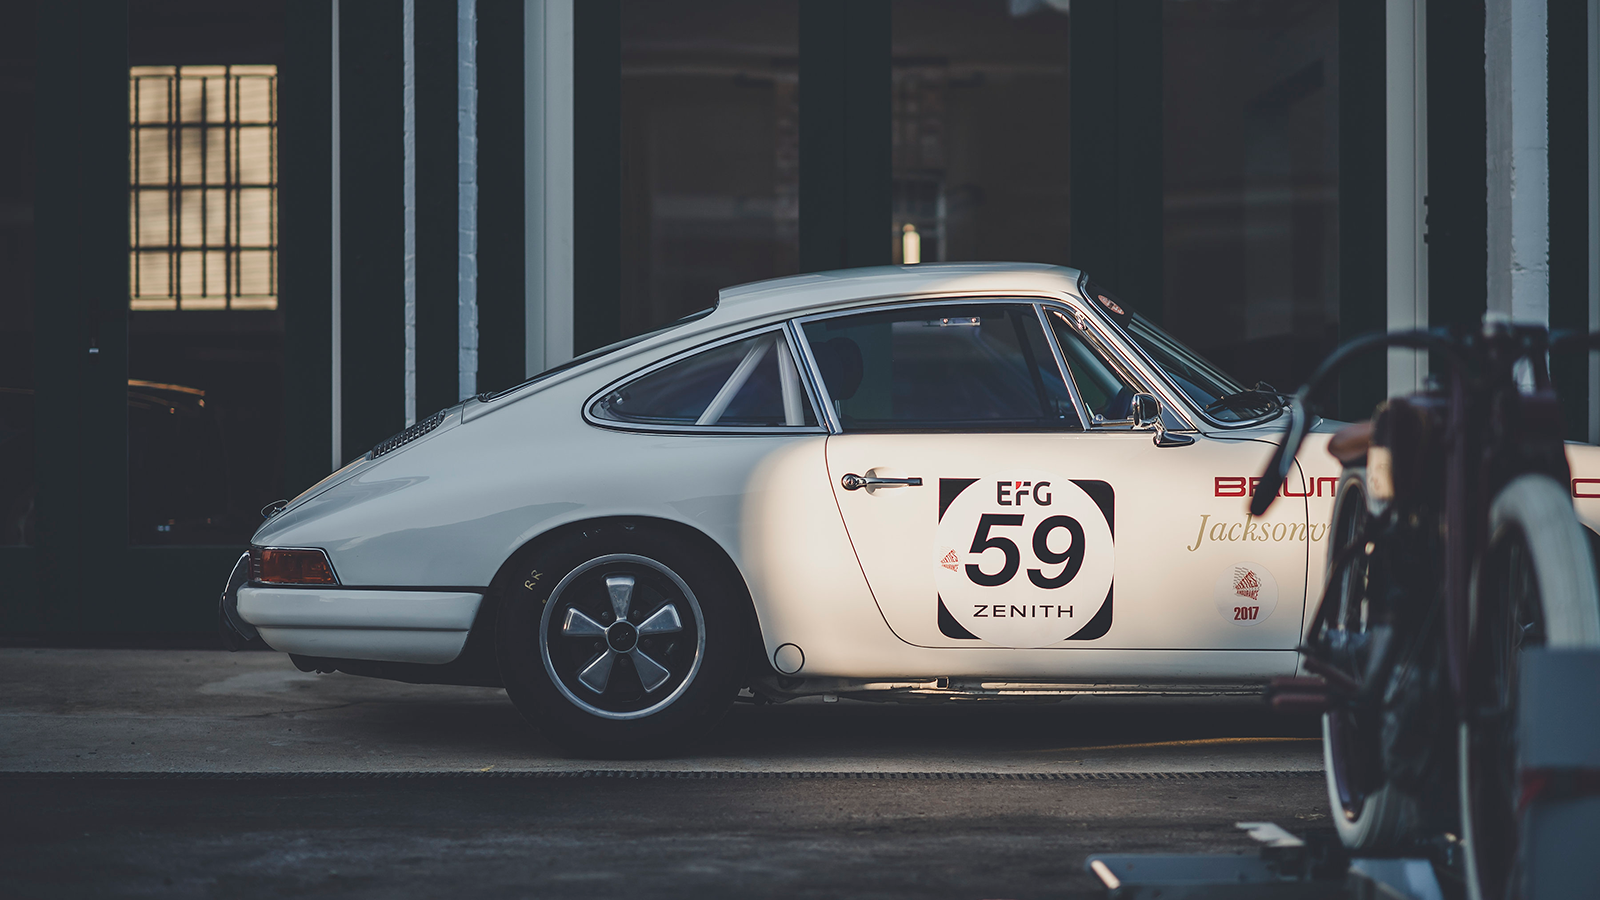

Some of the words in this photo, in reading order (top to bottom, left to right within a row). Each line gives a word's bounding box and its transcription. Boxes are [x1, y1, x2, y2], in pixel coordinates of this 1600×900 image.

[997, 481, 1052, 506] EFG
[1187, 513, 1332, 552] Jacksonv
[965, 513, 1086, 589] 59
[973, 604, 1074, 618] ZENITH
[1233, 606, 1260, 621] 2017
